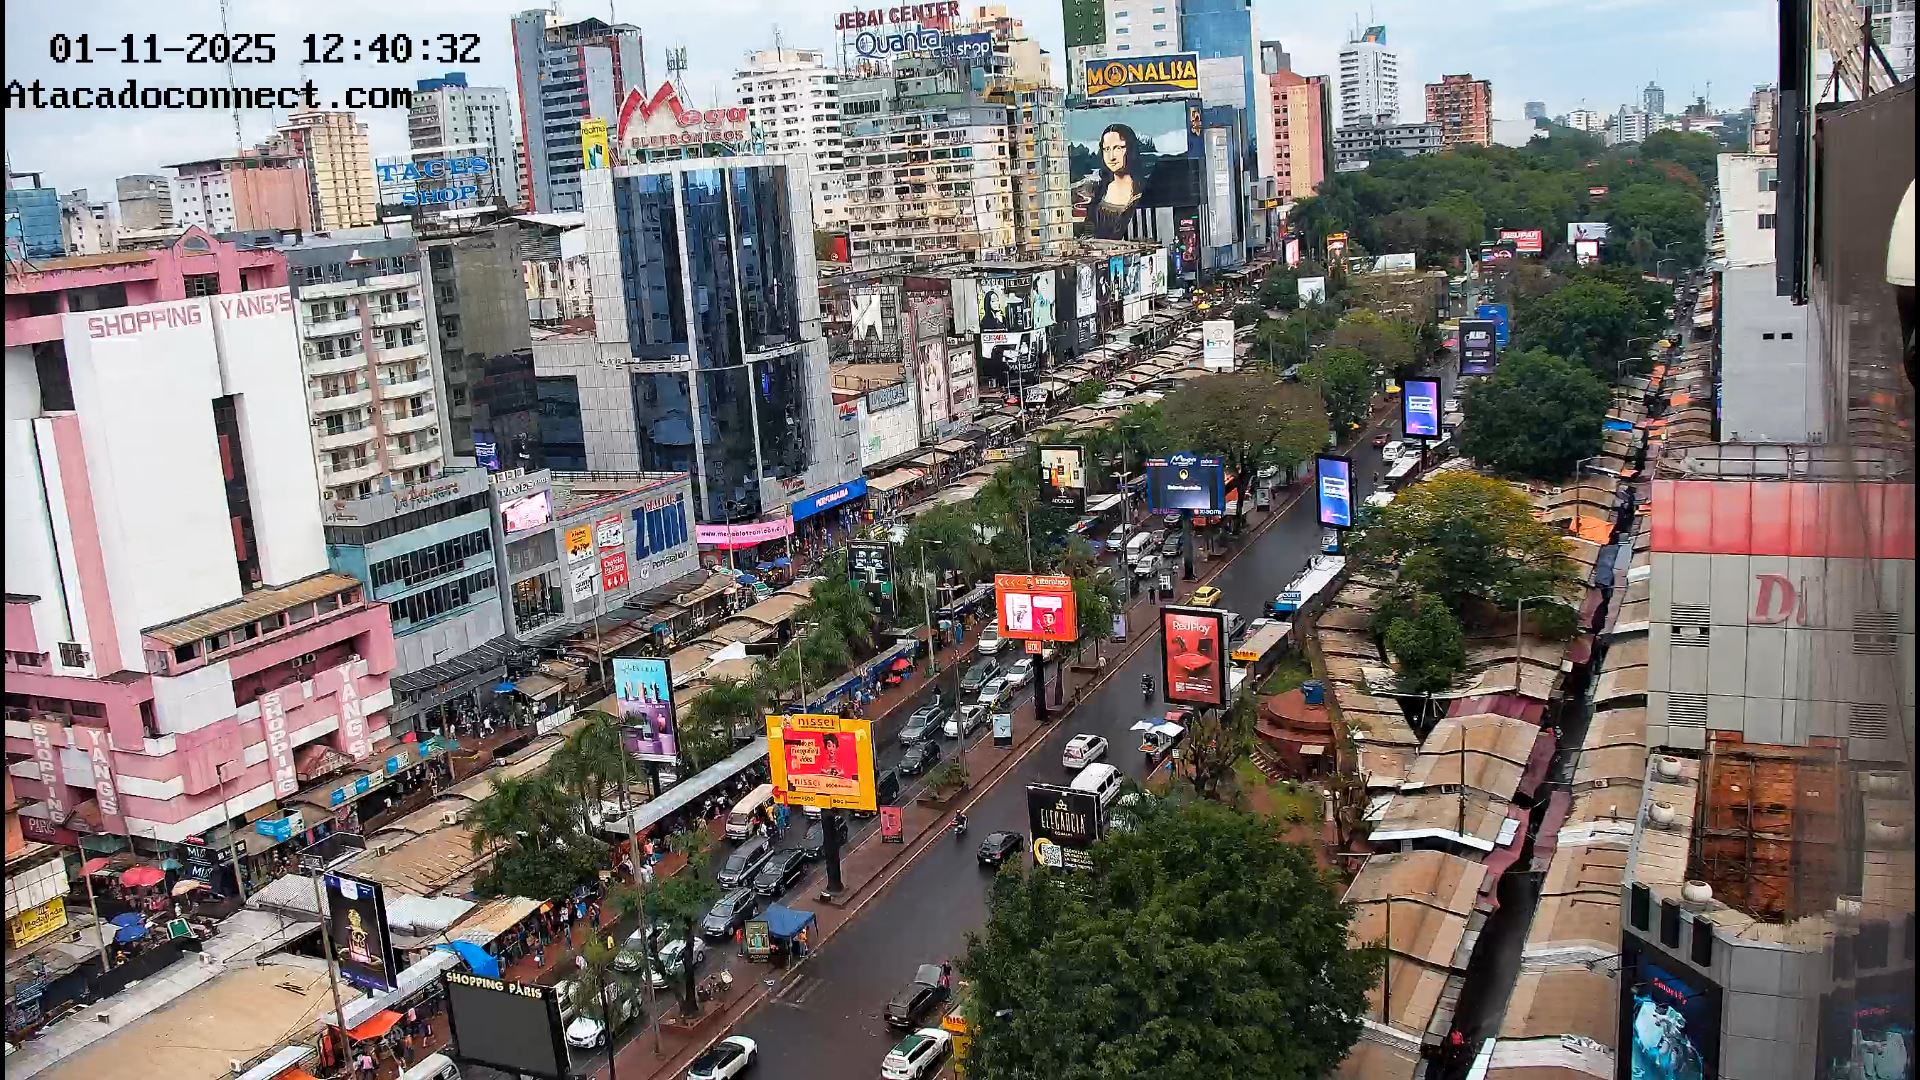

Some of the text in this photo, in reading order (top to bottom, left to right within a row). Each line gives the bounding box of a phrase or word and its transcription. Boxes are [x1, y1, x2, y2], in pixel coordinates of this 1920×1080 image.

[835, 1, 960, 30] JEBAI CENTER
[856, 24, 941, 59] Quanta
[1087, 60, 1197, 87] MONALISA
[617, 80, 748, 147] Mega
[376, 155, 490, 182] TACES
[402, 184, 479, 207] SHOP
[87, 292, 293, 339] SHOPPING YANG'S
[798, 717, 834, 727] nissei
[263, 692, 295, 791] SHOPPING
[32, 722, 66, 824] SHOPPING
[446, 972, 542, 998] SHOPPING PARIS
